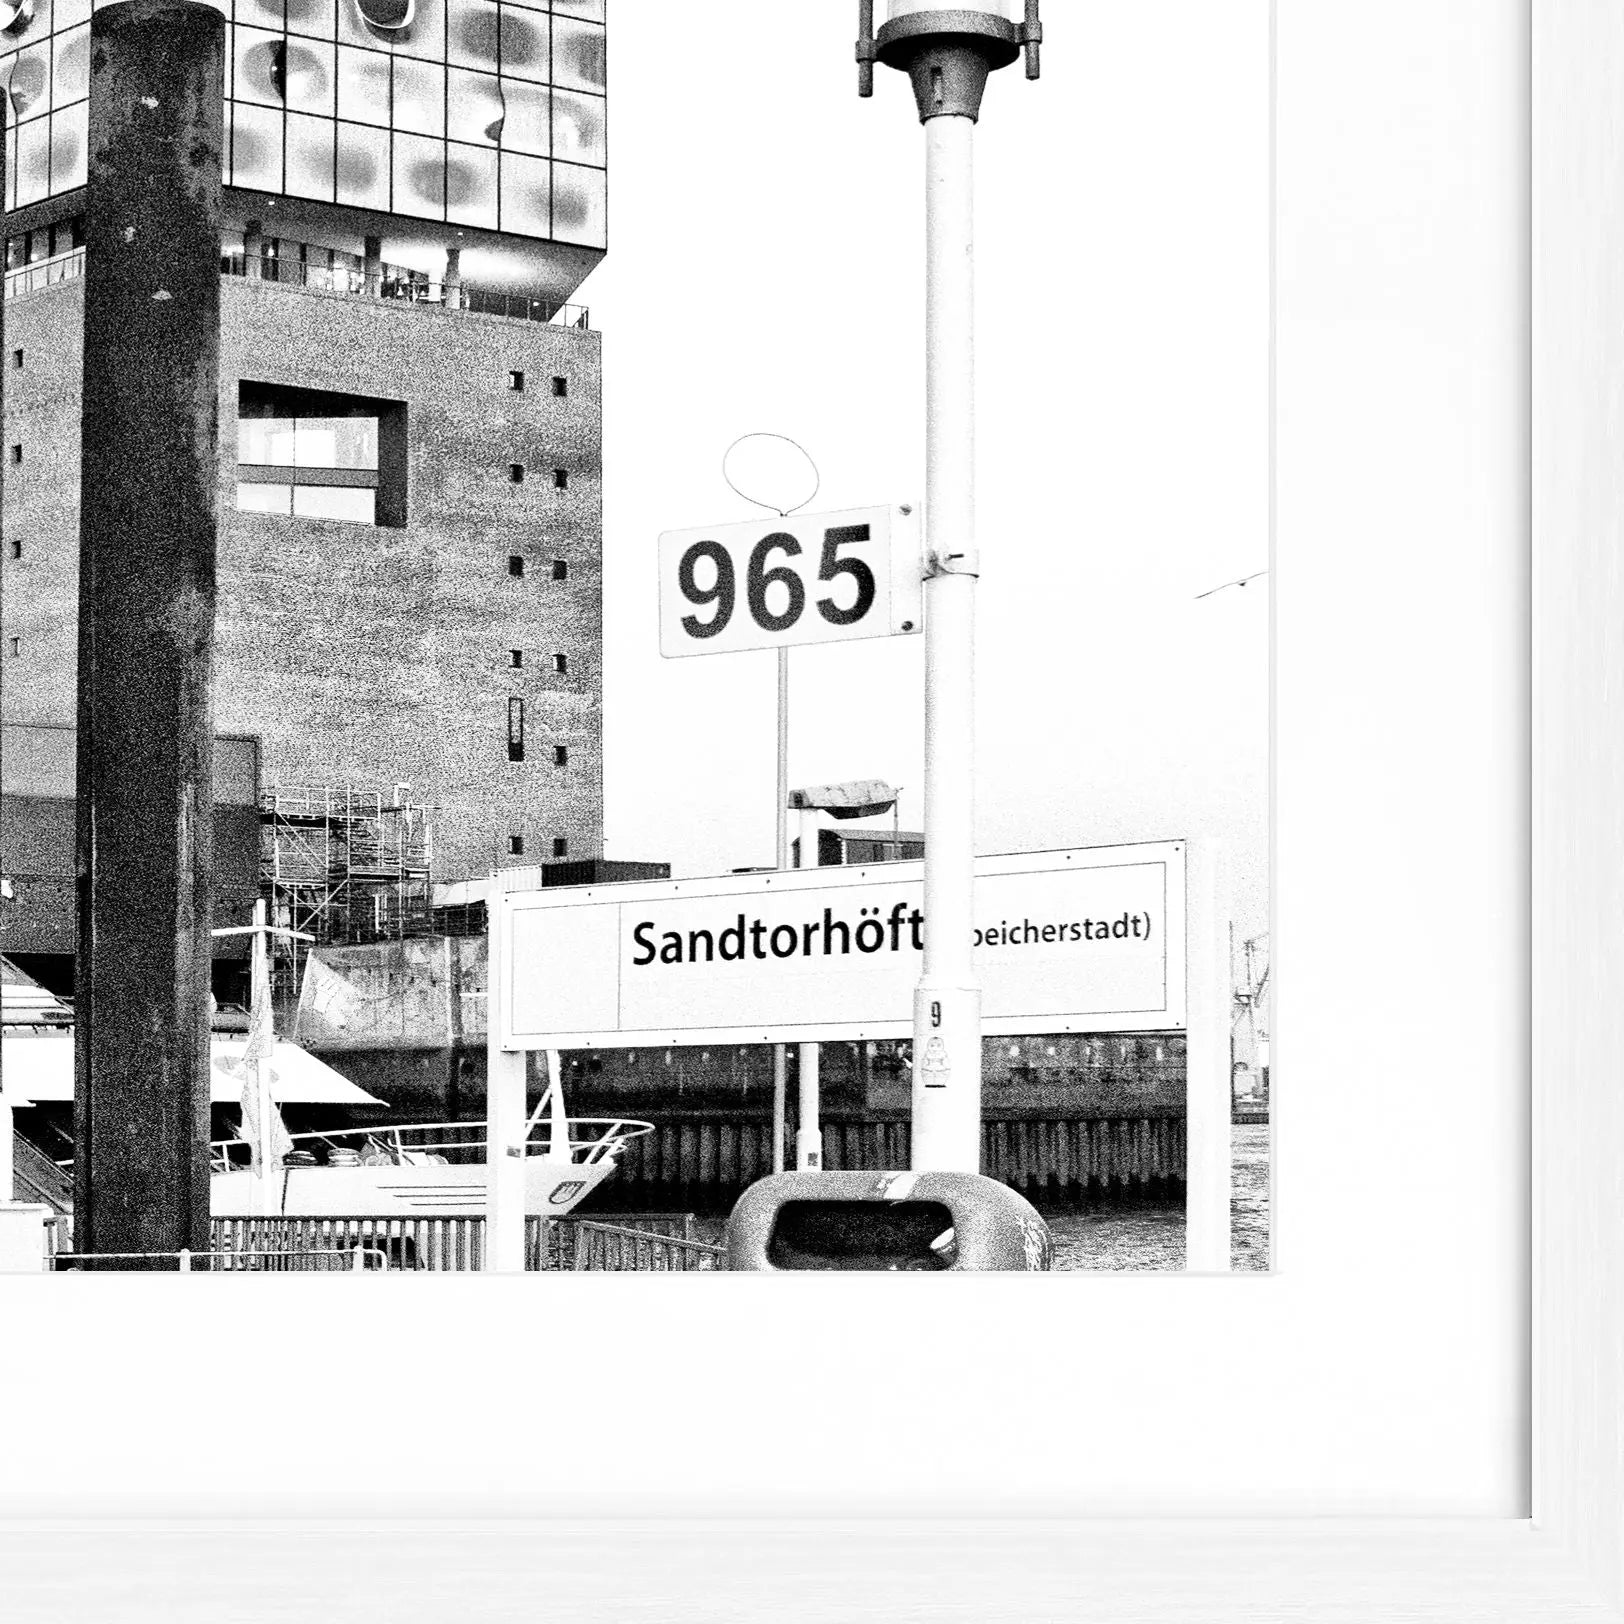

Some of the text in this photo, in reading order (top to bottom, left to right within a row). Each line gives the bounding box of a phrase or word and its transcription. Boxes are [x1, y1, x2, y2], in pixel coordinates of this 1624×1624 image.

[678, 523, 876, 639] 965
[632, 902, 924, 966] Sandtorhöft
[931, 1001, 942, 1028] 9
